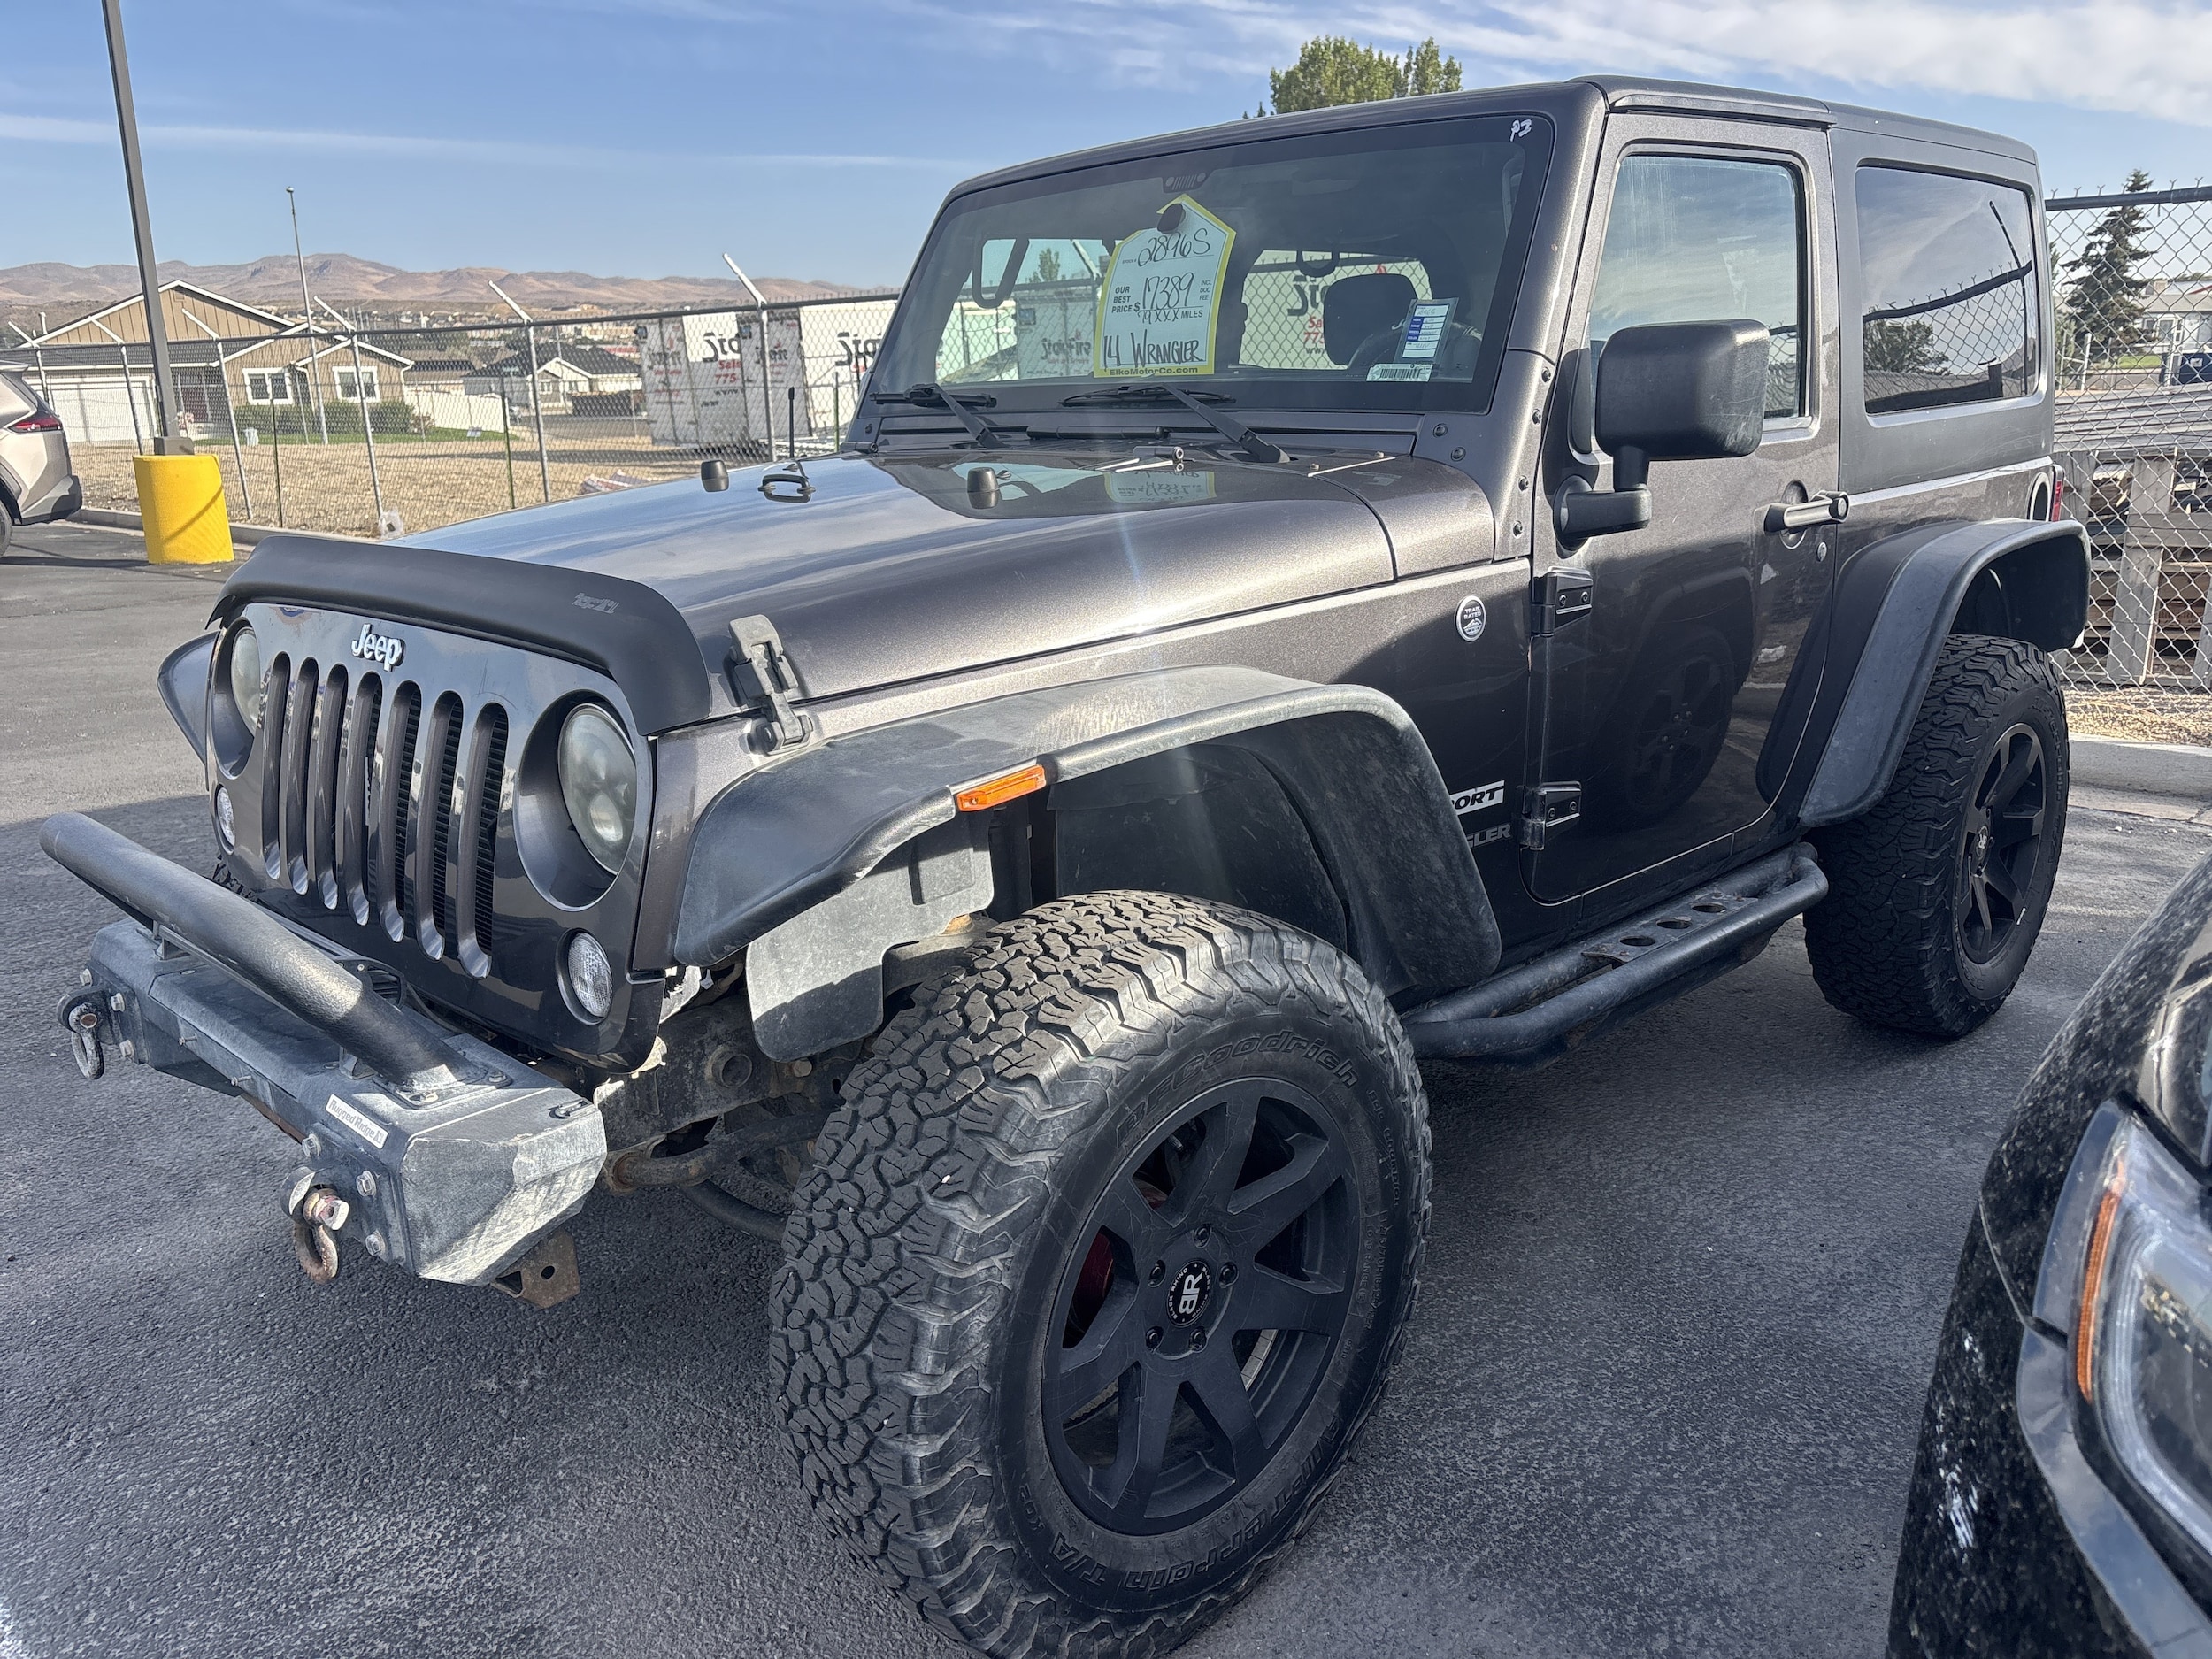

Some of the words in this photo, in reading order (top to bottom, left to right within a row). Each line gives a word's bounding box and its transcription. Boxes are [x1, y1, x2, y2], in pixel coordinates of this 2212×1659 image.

[1137, 227, 1210, 267] 2896S
[1111, 304, 1133, 313] PRICE
[1113, 295, 1131, 303] BEST
[1180, 310, 1203, 319] MILES
[1109, 366, 1198, 376] ElkoMotorCo.com
[1463, 611, 1482, 620] RATED
[351, 623, 404, 672] Jeep
[1451, 786, 1504, 810] ORT
[1115, 1030, 1360, 1148] BFGoodrich
[328, 1098, 356, 1124] Rugged
[355, 1115, 375, 1140] Ridge
[1171, 1267, 1188, 1292] RHINO
[1178, 1271, 1203, 1315] BR
[1168, 1294, 1179, 1320] BLACK
[1050, 1532, 1108, 1586] T/A
